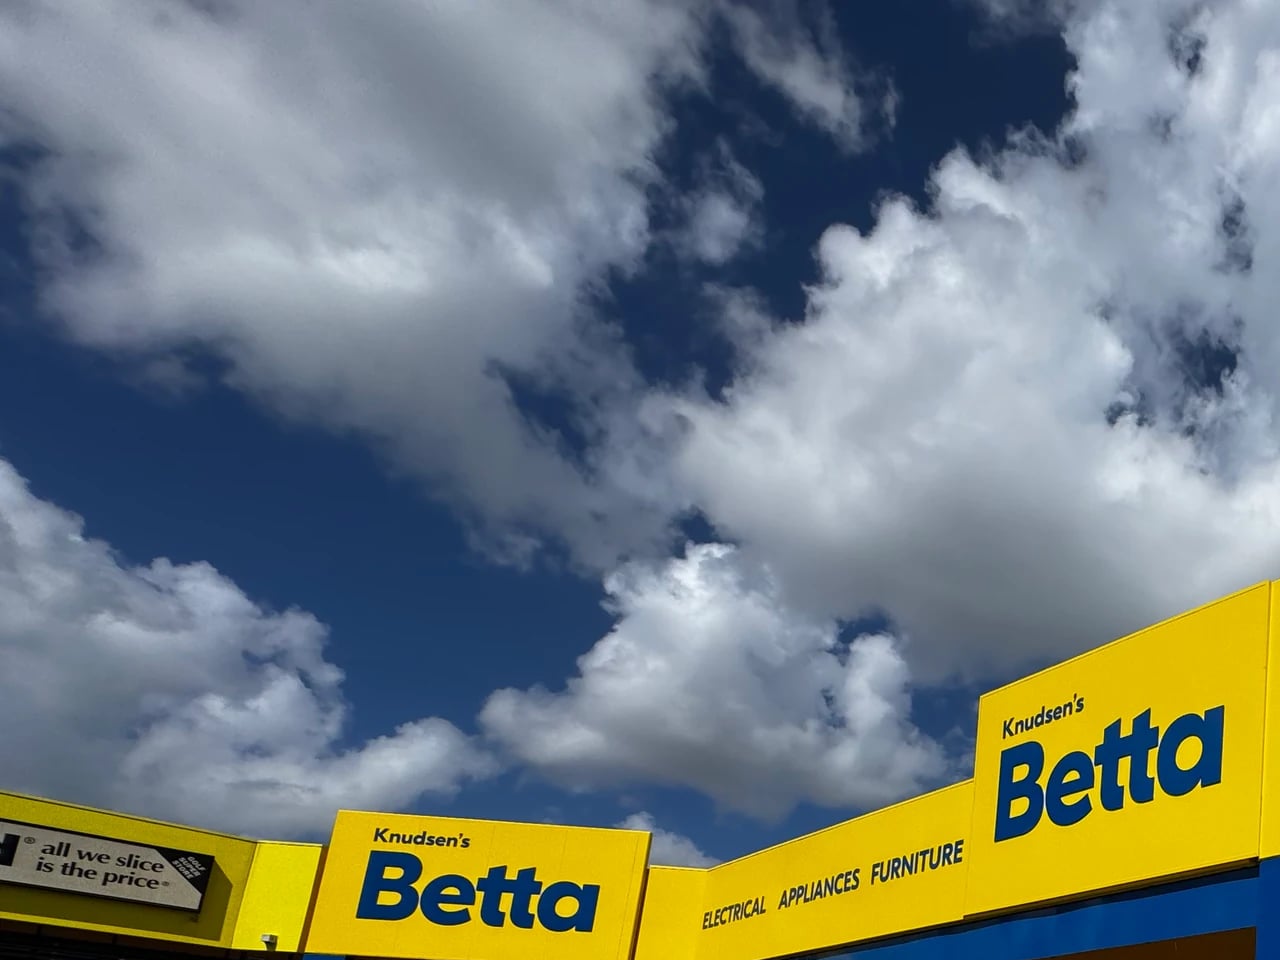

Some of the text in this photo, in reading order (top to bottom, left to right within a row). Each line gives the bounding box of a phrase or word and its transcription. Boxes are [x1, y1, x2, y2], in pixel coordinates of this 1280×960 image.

[1002, 693, 1085, 740] Knudsen's
[994, 704, 1225, 843] Betta
[373, 827, 471, 848] Knudsen's
[36, 857, 53, 873] is
[61, 861, 97, 880] the
[41, 841, 164, 873] all we slice
[172, 860, 195, 880] STORE
[179, 857, 201, 877] SUPER
[187, 856, 206, 871] GOLF
[355, 849, 600, 933] Betta
[701, 839, 964, 930] ELECTRICAL APPLIANCES FURNITURE
